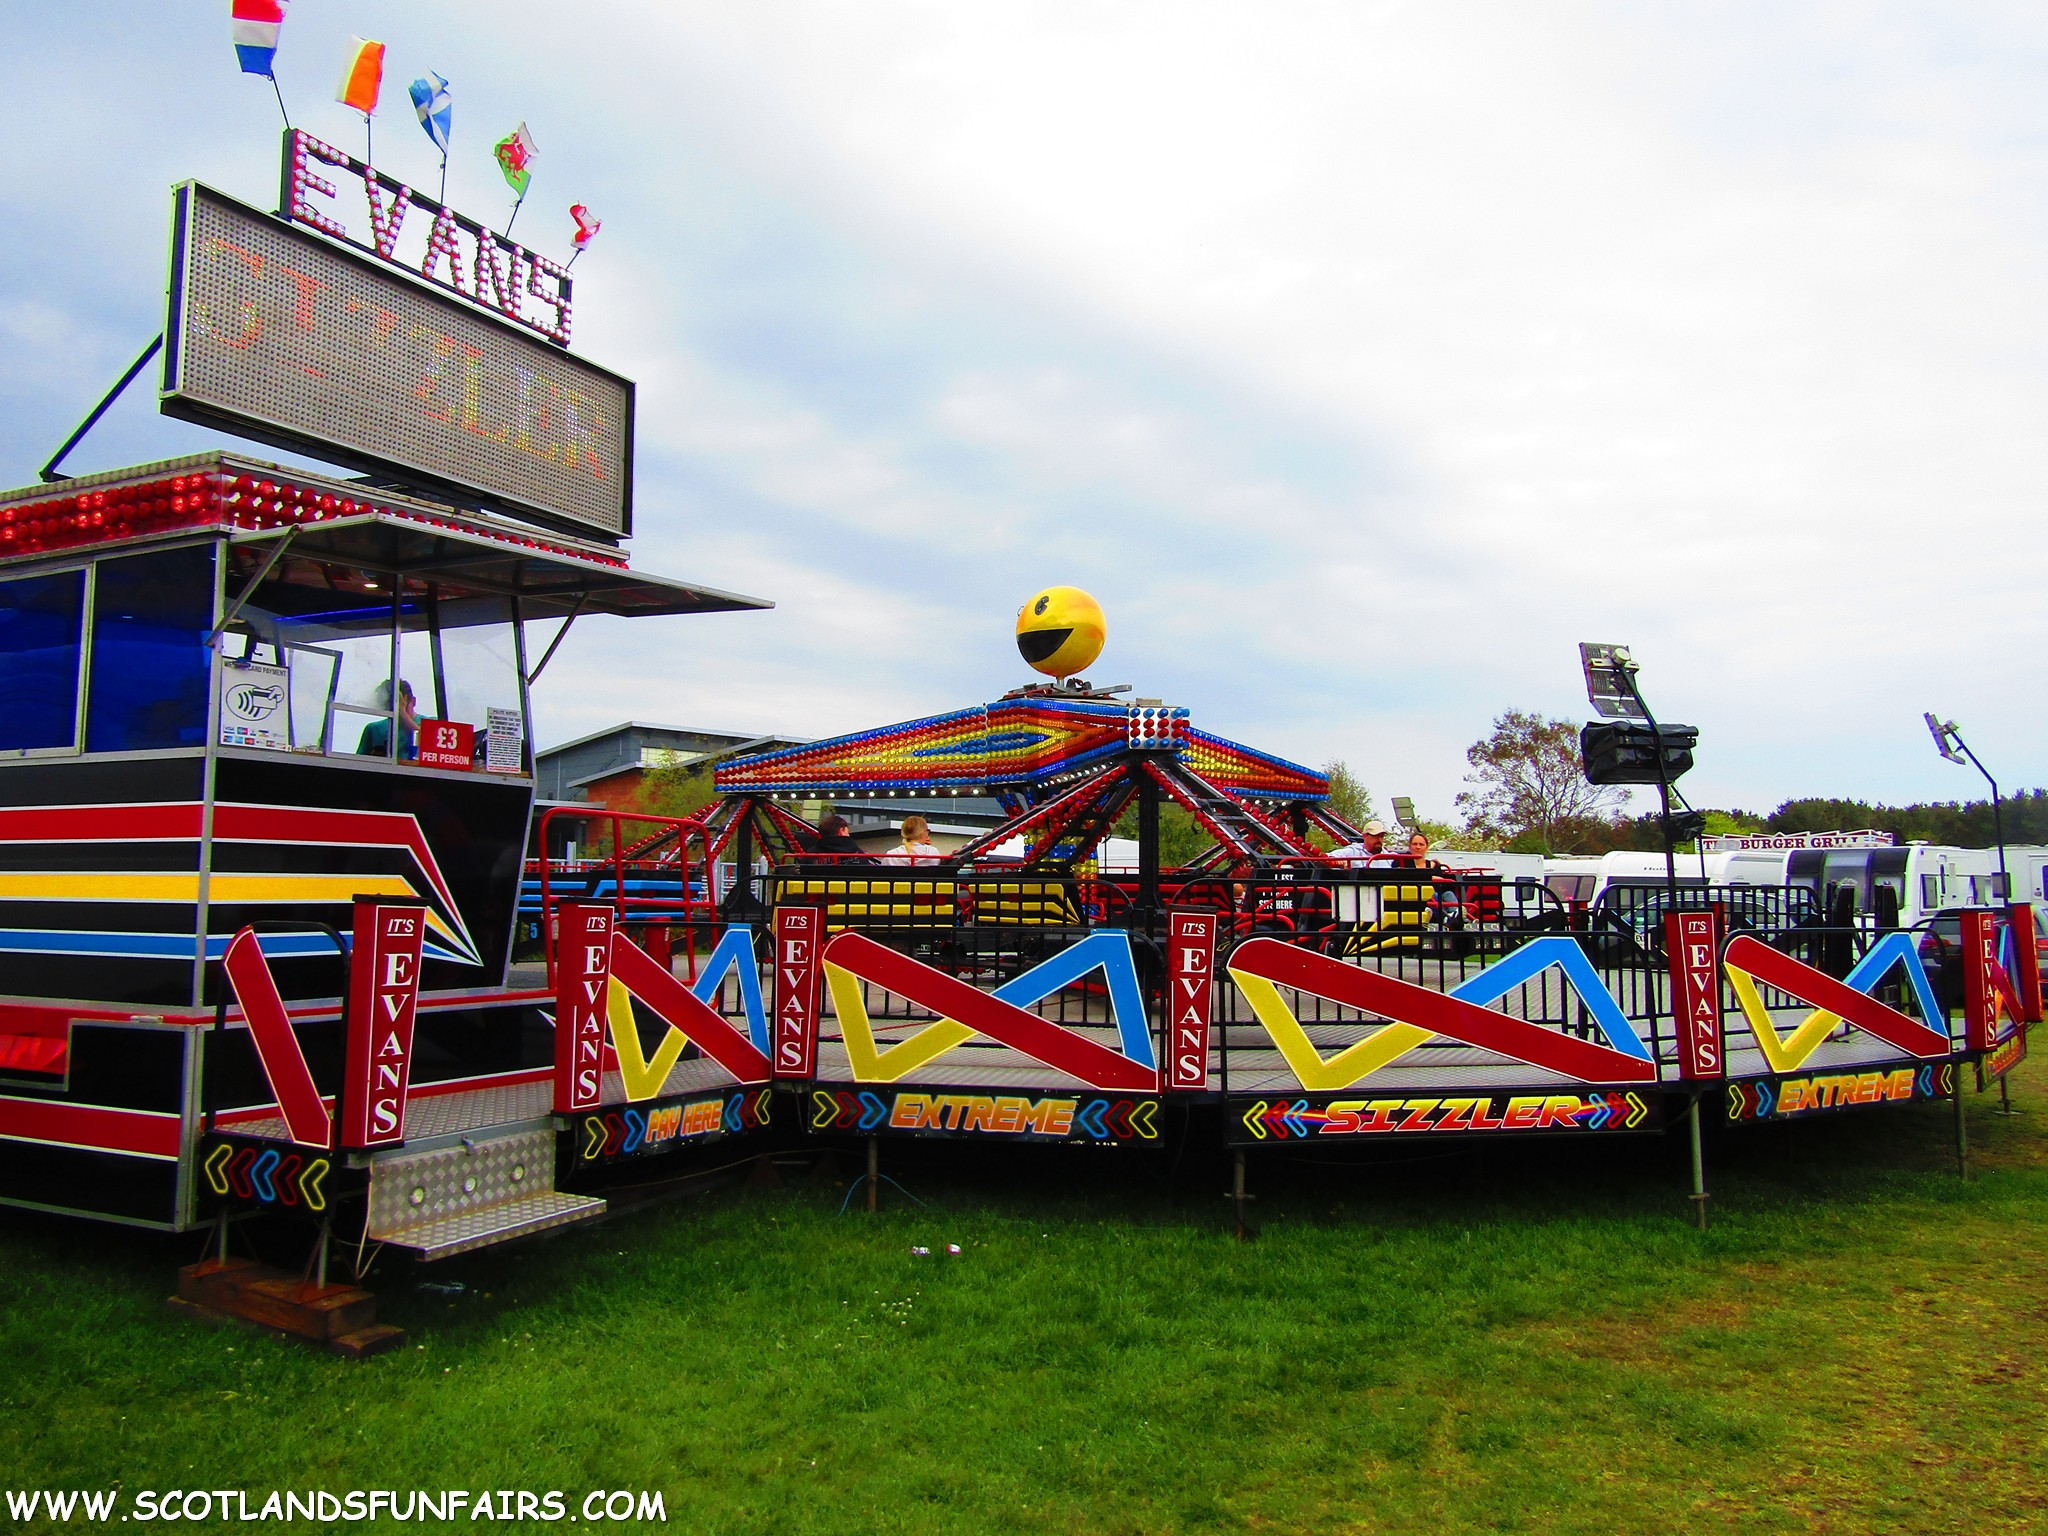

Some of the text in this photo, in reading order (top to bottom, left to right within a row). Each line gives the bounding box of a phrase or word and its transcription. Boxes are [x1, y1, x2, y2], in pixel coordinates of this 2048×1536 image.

[290, 128, 573, 344] EVANS
[262, 667, 286, 676] PAYMENT
[436, 727, 458, 750] £3
[422, 751, 470, 765] PER PERSON
[1740, 837, 1805, 849] BURGER
[1275, 899, 1293, 910] HERE
[387, 919, 414, 933] IT'S
[529, 923, 538, 938] 5
[587, 917, 606, 929] IT'S
[786, 916, 808, 927] IT'S
[1182, 922, 1206, 934] IT'S
[1688, 921, 1707, 932] IT'S
[781, 940, 809, 1067] EVANS
[1689, 944, 1716, 1068] EVANS
[1983, 939, 1996, 1042] EVANS
[578, 946, 606, 1099] EVANS
[1179, 948, 1207, 1081] EVANS
[373, 953, 413, 1134] EVANS
[1776, 1069, 1915, 1112] EXTREME
[645, 1099, 724, 1143] PAY HERE
[889, 1093, 1077, 1135] EXTREME
[1318, 1095, 1581, 1134] SIZZLER
